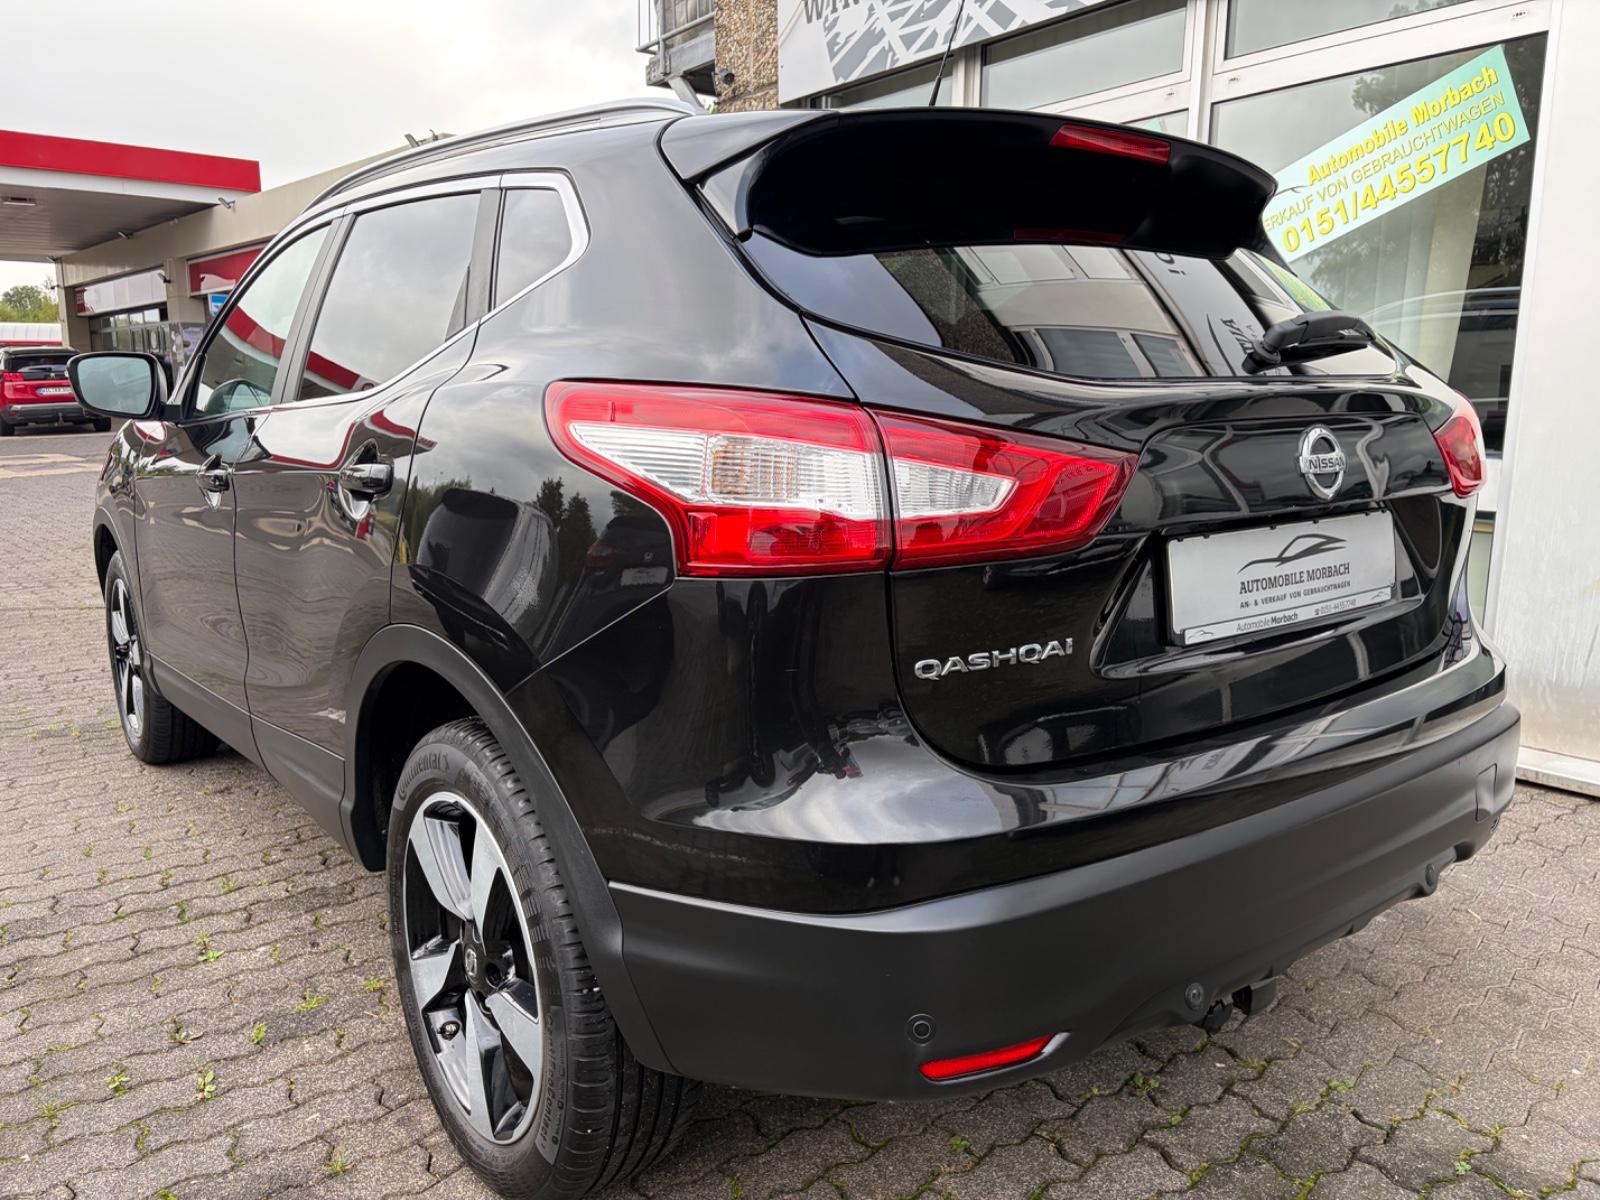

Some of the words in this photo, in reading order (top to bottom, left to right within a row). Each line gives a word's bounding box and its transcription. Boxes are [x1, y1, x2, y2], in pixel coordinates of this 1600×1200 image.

[1263, 194, 1313, 232] ERKAUF
[1316, 176, 1349, 202] VON
[1351, 90, 1505, 184] GEBRAUCHTWAGEN
[1308, 119, 1408, 187] Automobile
[1410, 66, 1498, 127] Morbach
[1282, 111, 1516, 252] 0151/44557740
[1239, 570, 1304, 595] AUTOMOBILE
[1306, 562, 1350, 582] MORBACH
[1260, 593, 1287, 605] VERKAUF
[1289, 591, 1302, 600] VON
[1303, 580, 1351, 597] GEBRAUCHTWAGEN
[914, 637, 1074, 681] QASHQAI
